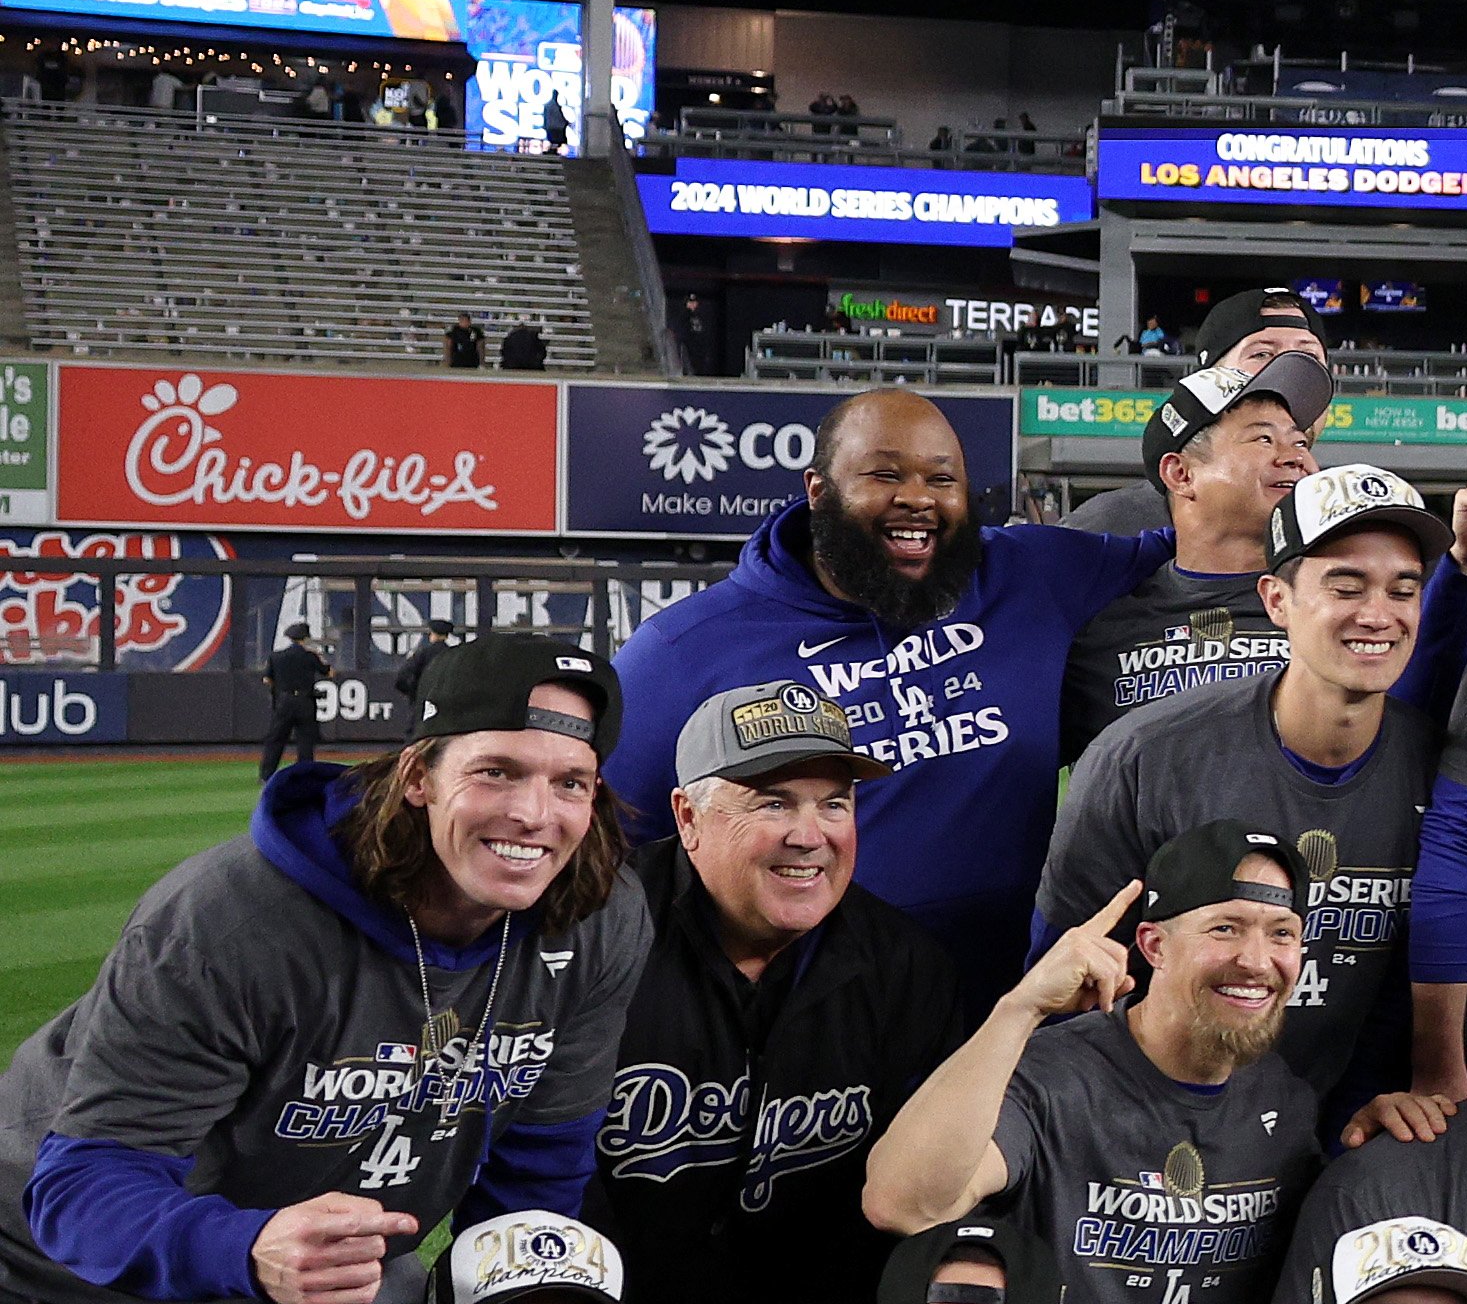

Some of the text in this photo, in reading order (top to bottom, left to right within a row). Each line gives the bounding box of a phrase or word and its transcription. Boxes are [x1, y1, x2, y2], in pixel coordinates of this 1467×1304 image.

[476, 60, 638, 109] WORD
[1217, 133, 1429, 166] CONGRATULATIONS
[1140, 162, 1202, 187] LOS
[1206, 164, 1347, 193] ANGELES
[671, 180, 1059, 227] 2024 WORLD SERIES CHAMPIONS
[837, 292, 938, 324] freshdirect
[1037, 394, 1154, 424] bet365
[125, 405, 499, 520] Chick-fil-A
[642, 492, 713, 516] Make
[805, 622, 985, 699] WORLD
[1117, 634, 1291, 676] WORLD SER
[847, 670, 982, 729] 20 24
[739, 714, 808, 746] WORLD
[1085, 1182, 1279, 1226] WORLD SERIES
